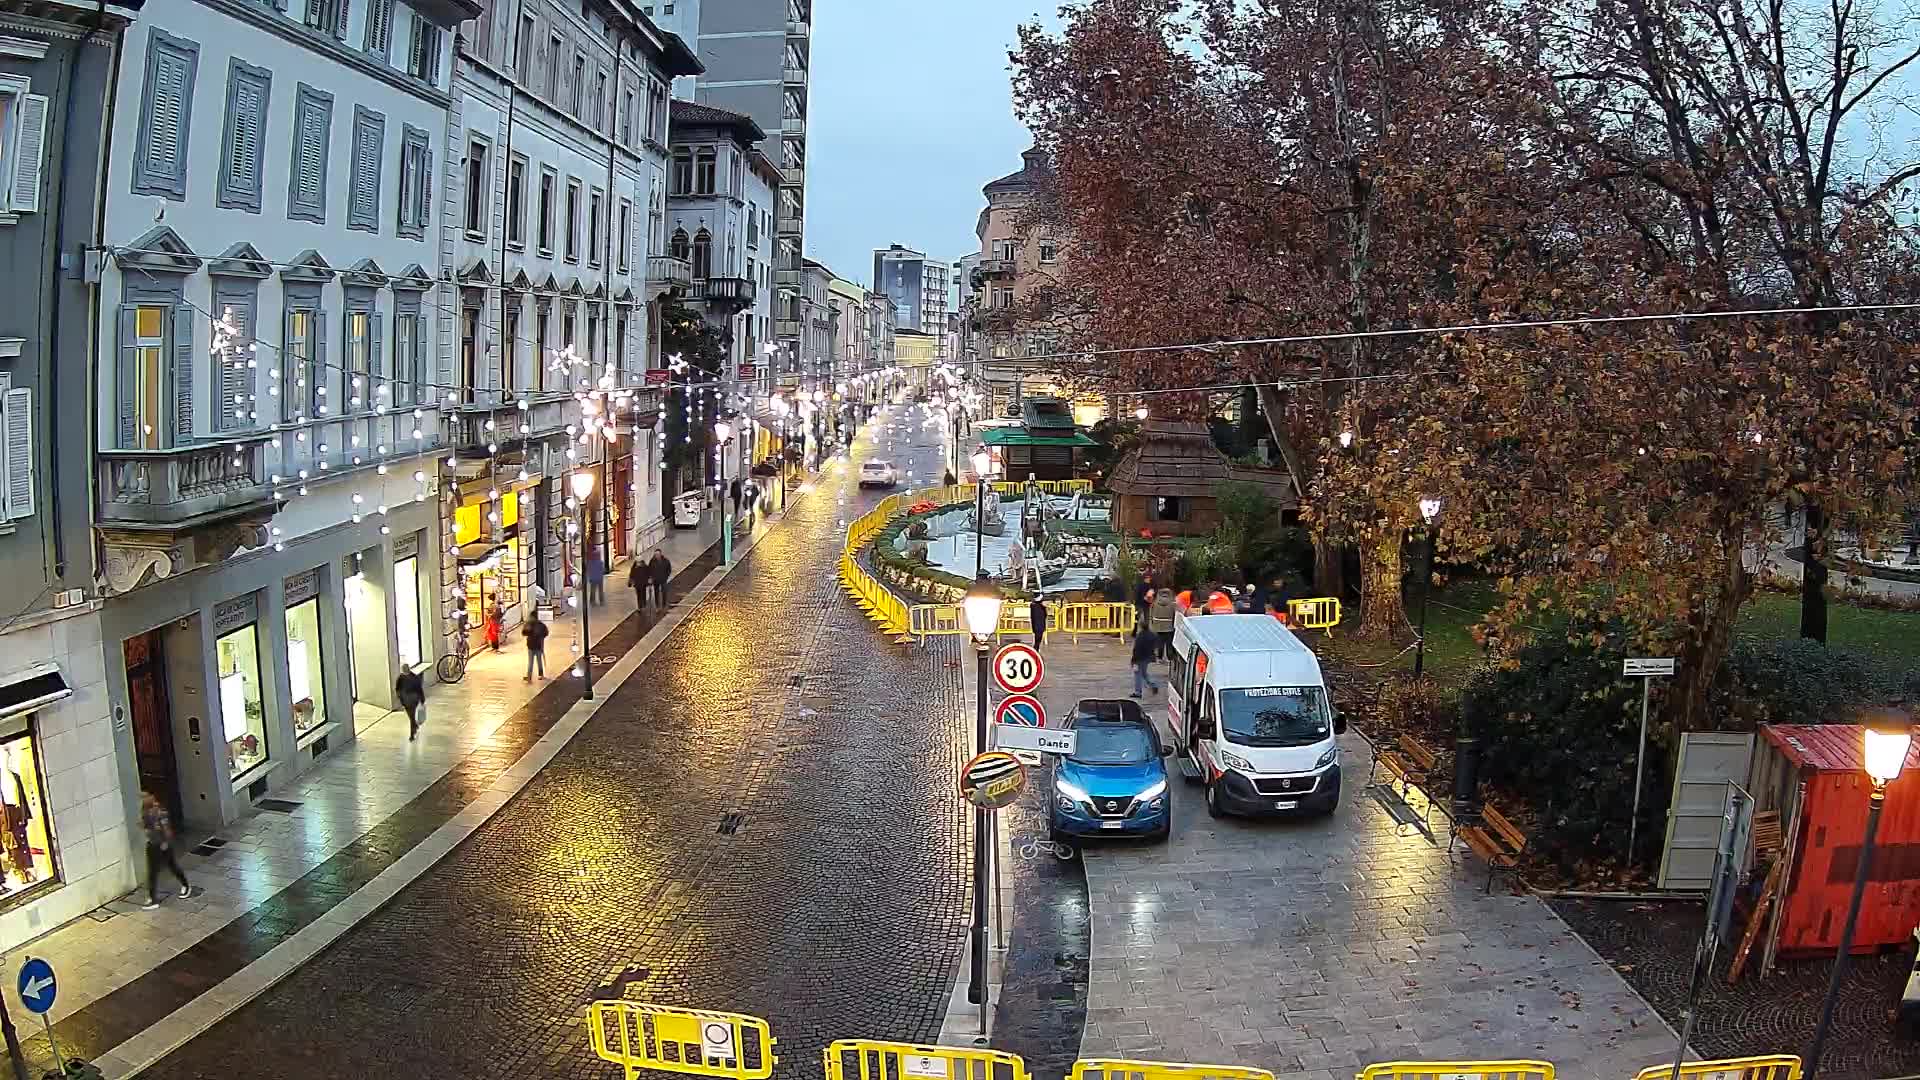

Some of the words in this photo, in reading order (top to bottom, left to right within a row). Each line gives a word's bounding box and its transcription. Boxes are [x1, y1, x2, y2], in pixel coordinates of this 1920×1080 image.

[1006, 658, 1033, 680] 30
[1244, 687, 1281, 697] PROTEZIONE
[1282, 687, 1302, 696] CIVILE
[1038, 737, 1070, 749] Dante
